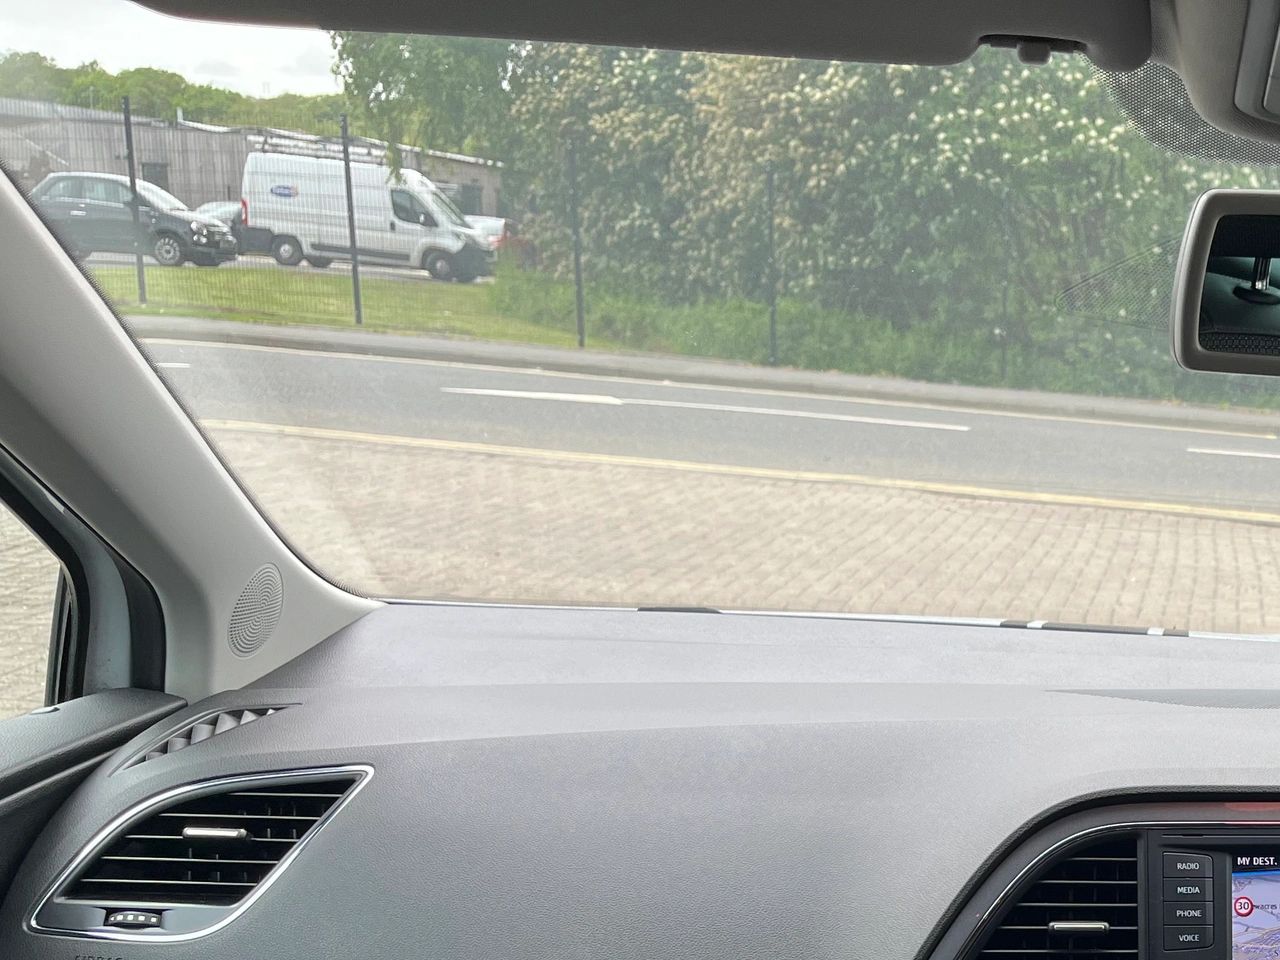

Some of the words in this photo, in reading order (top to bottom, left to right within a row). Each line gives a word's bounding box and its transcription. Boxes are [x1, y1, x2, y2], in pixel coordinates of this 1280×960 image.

[1237, 857, 1250, 866] MY
[1253, 857, 1278, 866] DEST.
[1176, 862, 1200, 870] RADIO
[1177, 886, 1201, 894] MEDIA
[1237, 901, 1250, 910] 30
[1176, 909, 1203, 917] PHONE
[1178, 934, 1200, 942] VOICE
